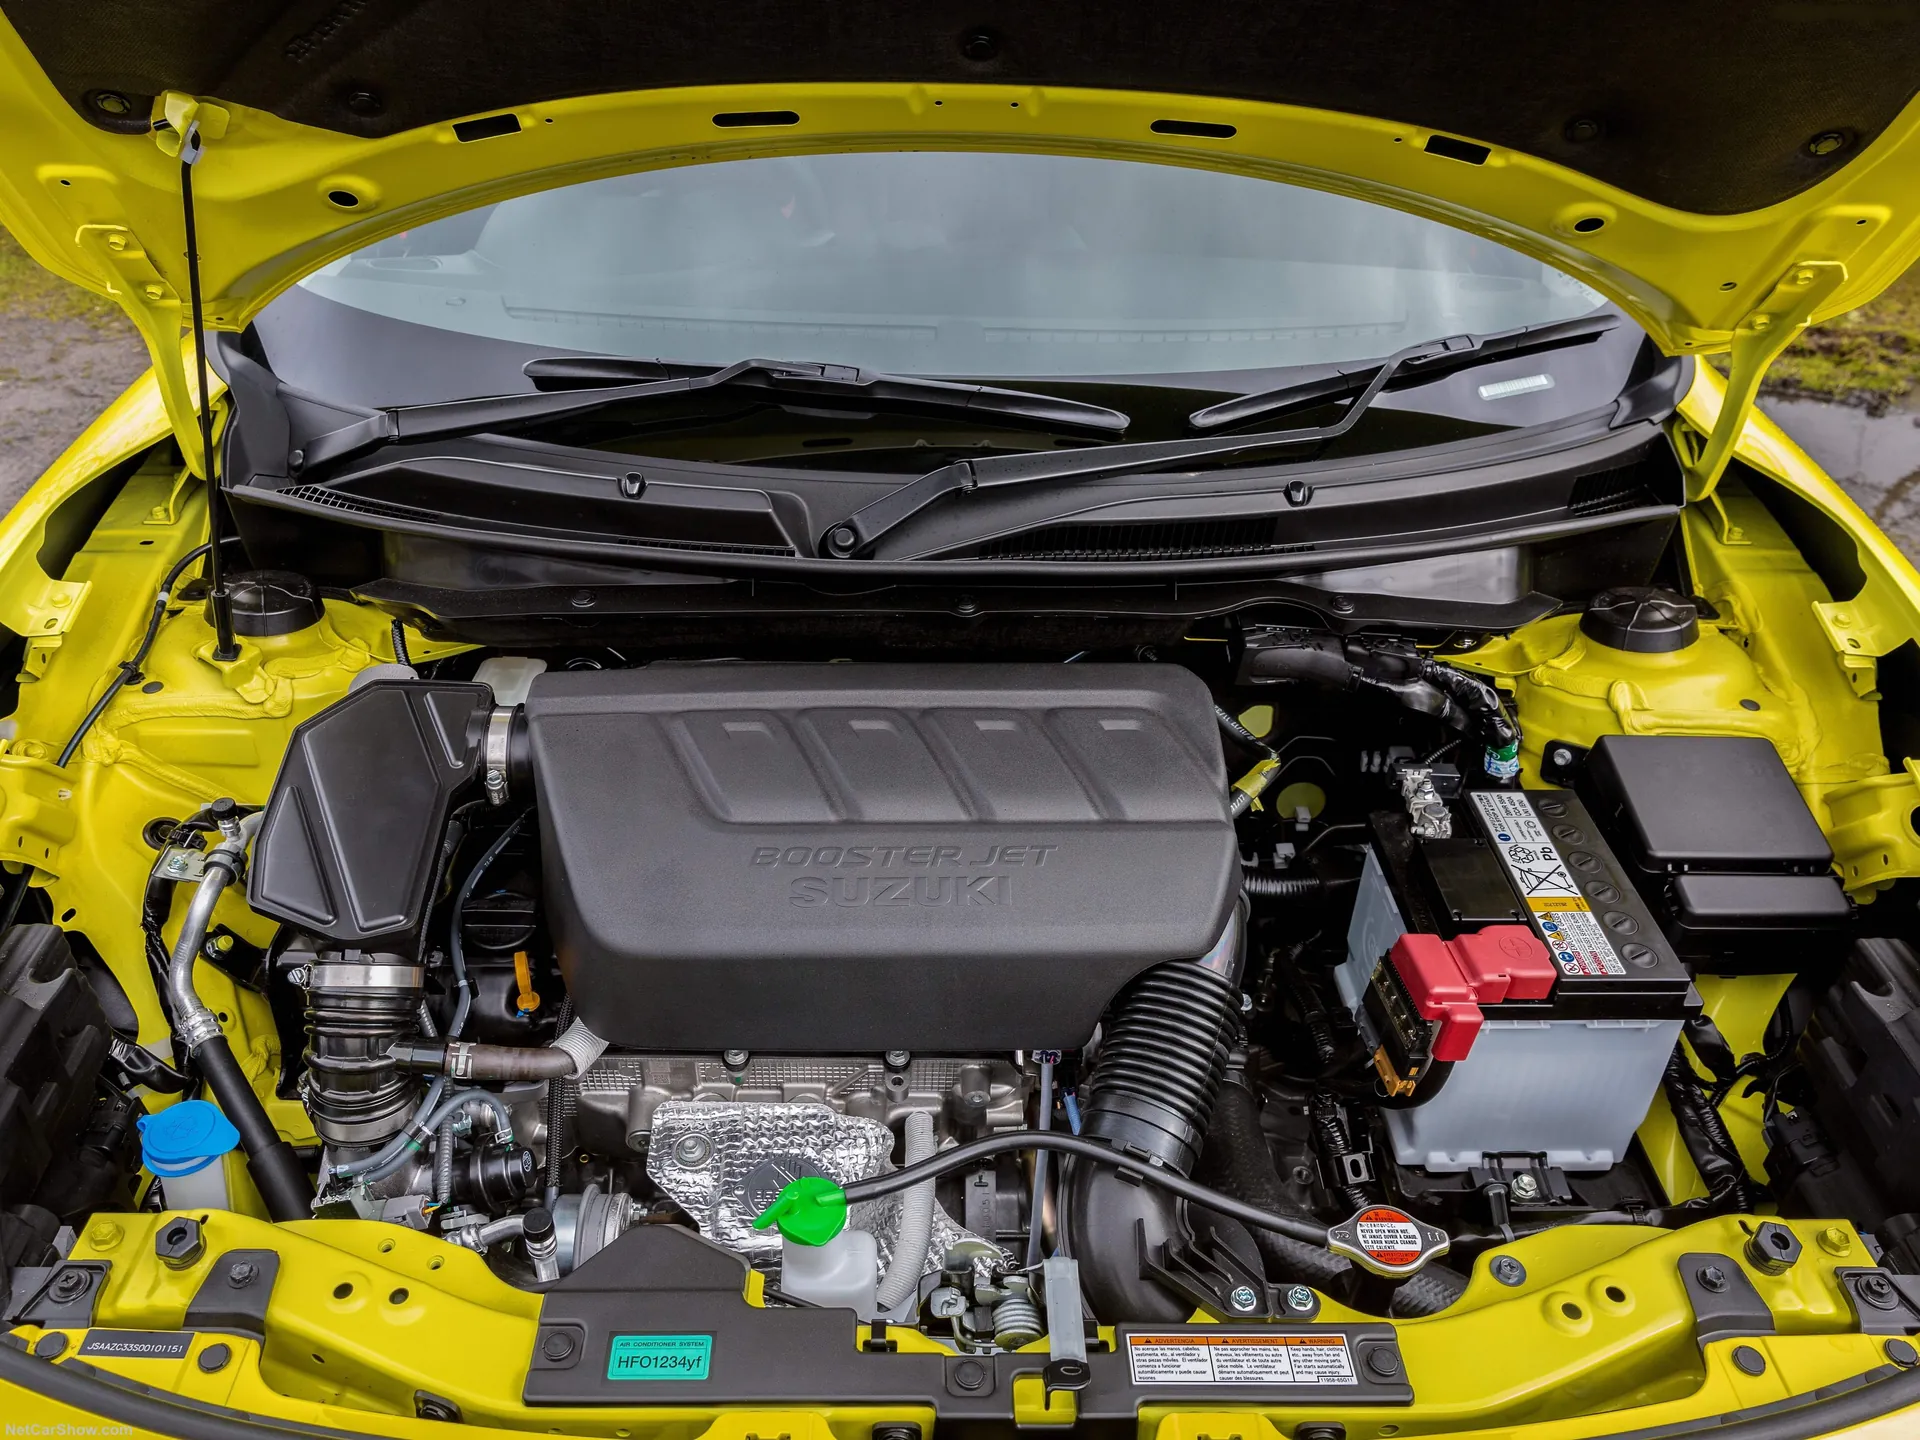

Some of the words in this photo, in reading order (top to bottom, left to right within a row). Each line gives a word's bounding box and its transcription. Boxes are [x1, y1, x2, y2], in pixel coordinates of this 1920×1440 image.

[1483, 795, 1494, 807] START
[1492, 812, 1501, 822] STOP
[1512, 807, 1522, 815] CCA
[1541, 847, 1557, 860] Pb
[788, 876, 1012, 908] SUZUKI
[1552, 913, 1564, 926] GASES
[1569, 913, 1579, 923] BURNS
[1575, 924, 1586, 936] SEVERE
[1563, 928, 1577, 950] EXPLOSIVE
[1582, 938, 1594, 949] CAUSES
[87, 1343, 183, 1352] JSAAZC33S00101151
[618, 1356, 702, 1371] HFO1234yf
